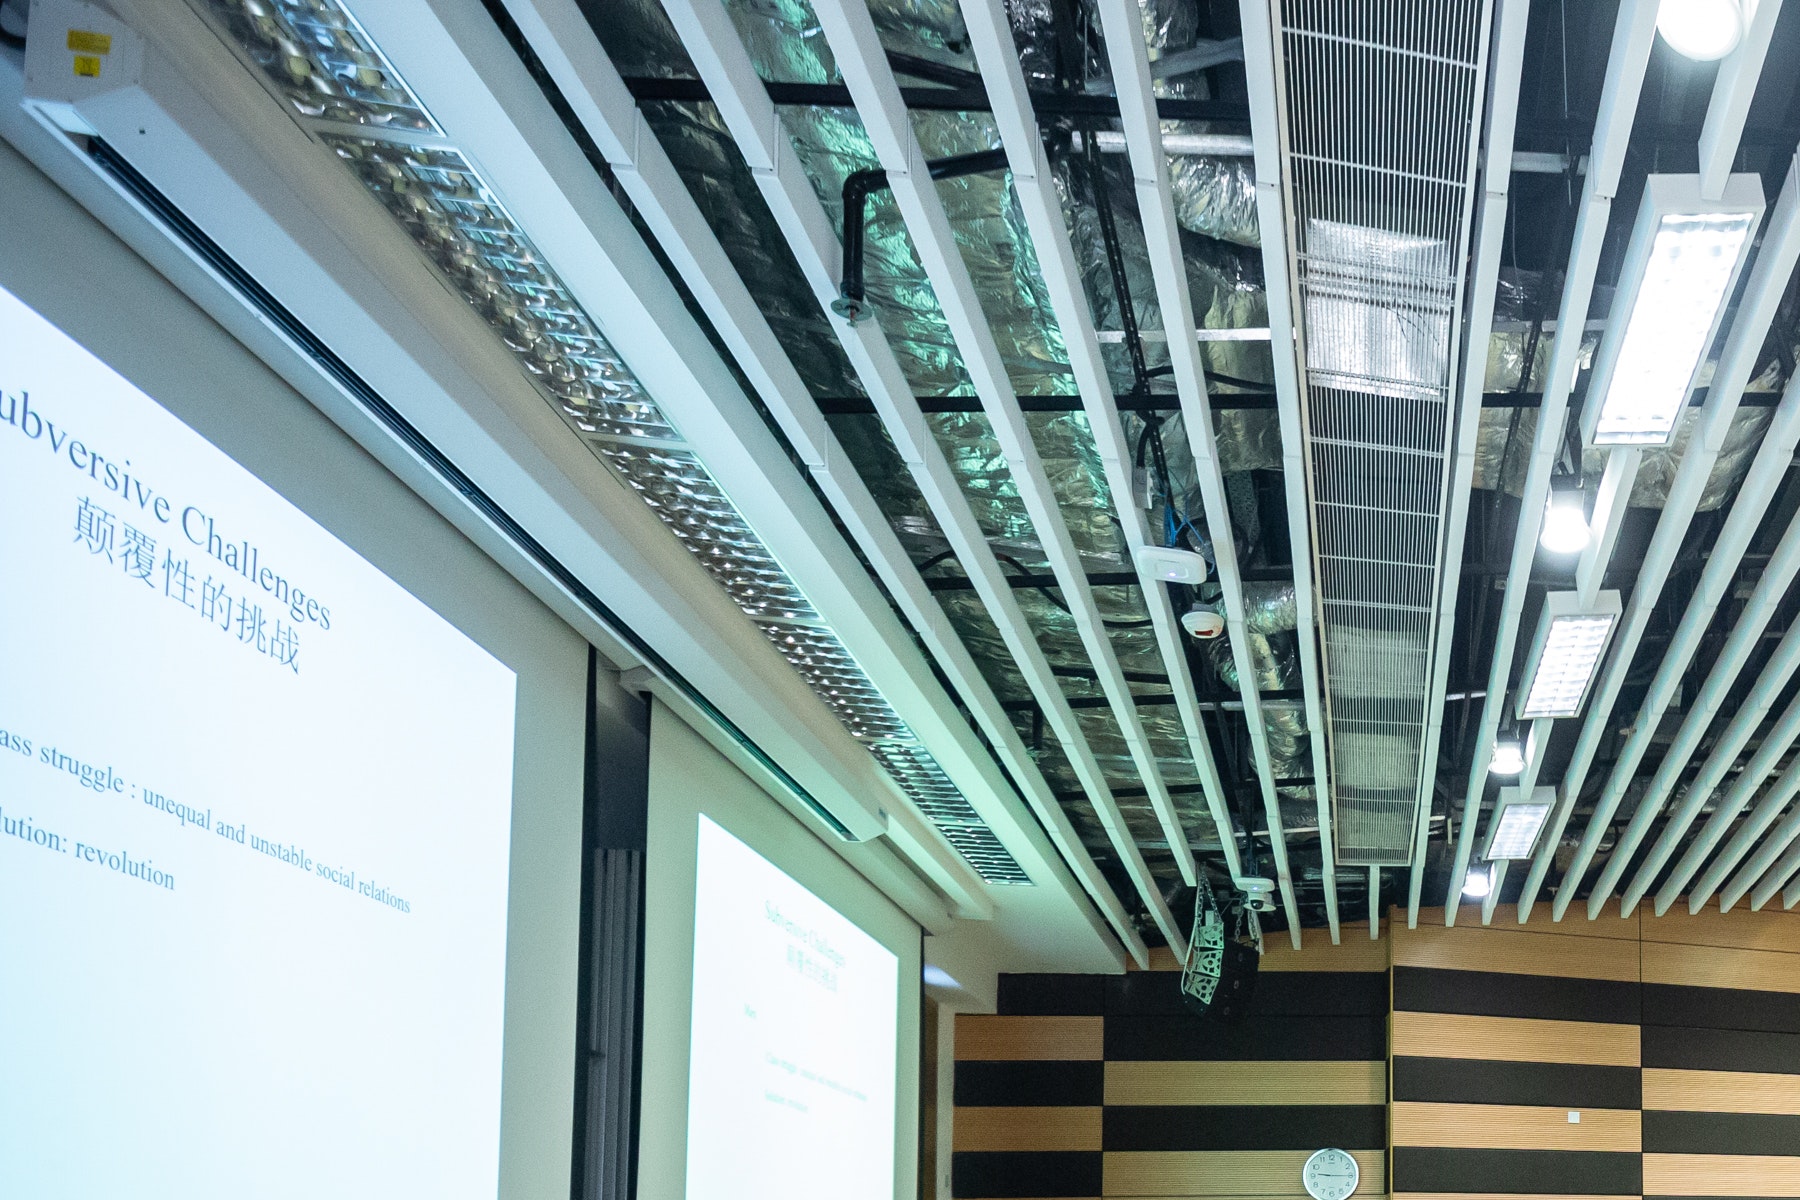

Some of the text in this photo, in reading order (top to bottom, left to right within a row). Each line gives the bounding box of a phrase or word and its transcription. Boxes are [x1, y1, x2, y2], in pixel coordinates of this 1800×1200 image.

[0, 389, 331, 630] ubversive Challenges
[73, 496, 299, 675] 颠覆性的挑战
[40, 746, 124, 793] struggle
[143, 786, 211, 830] unequal
[216, 818, 245, 845] and
[250, 832, 312, 872] unstable
[316, 861, 354, 891] social
[358, 879, 411, 914] relations
[75, 841, 175, 891] revolution
